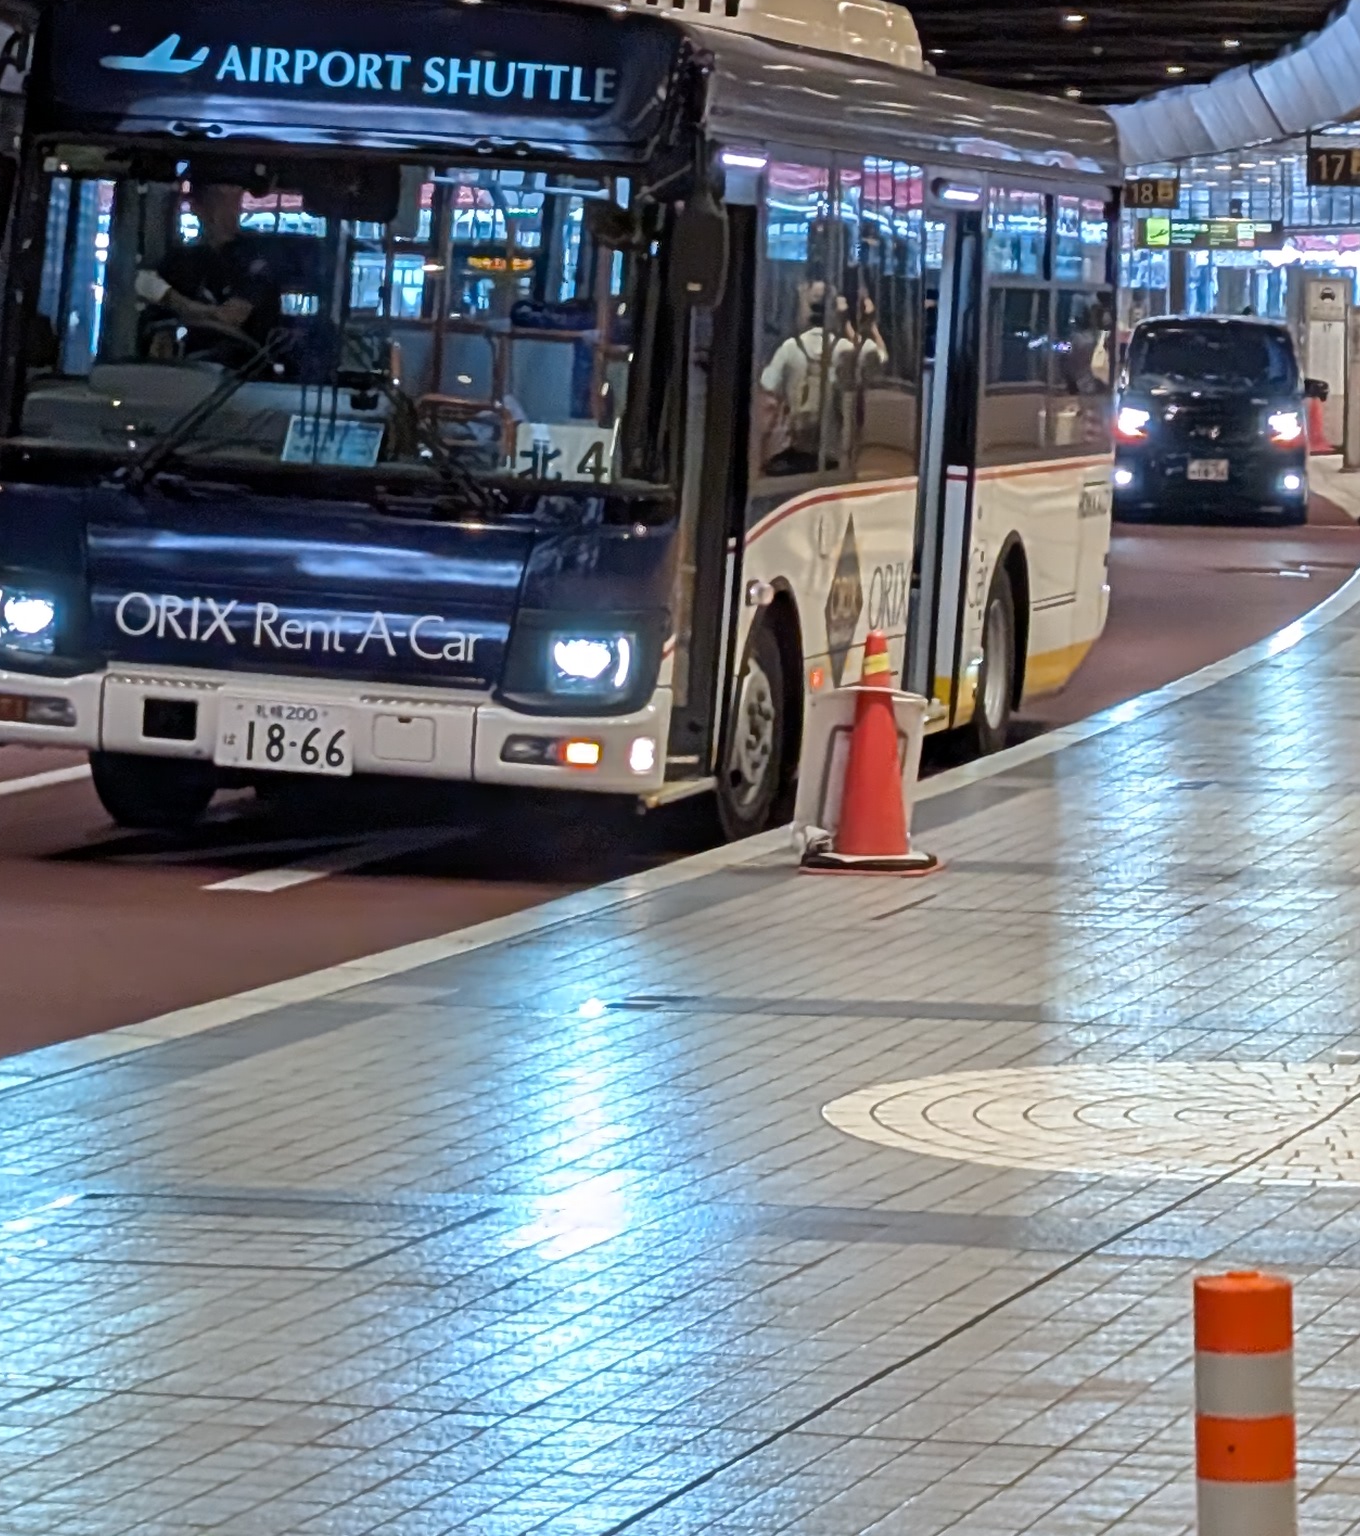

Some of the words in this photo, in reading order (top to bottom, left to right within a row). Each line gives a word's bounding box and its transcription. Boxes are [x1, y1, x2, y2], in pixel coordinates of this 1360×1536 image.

[215, 43, 412, 94] AIRPORT
[423, 56, 618, 105] SHUTTLE
[1317, 154, 1346, 181] 17
[1131, 182, 1154, 204] 18
[577, 440, 608, 483] 4
[116, 591, 238, 644] ORIX
[869, 561, 913, 631] ORIX
